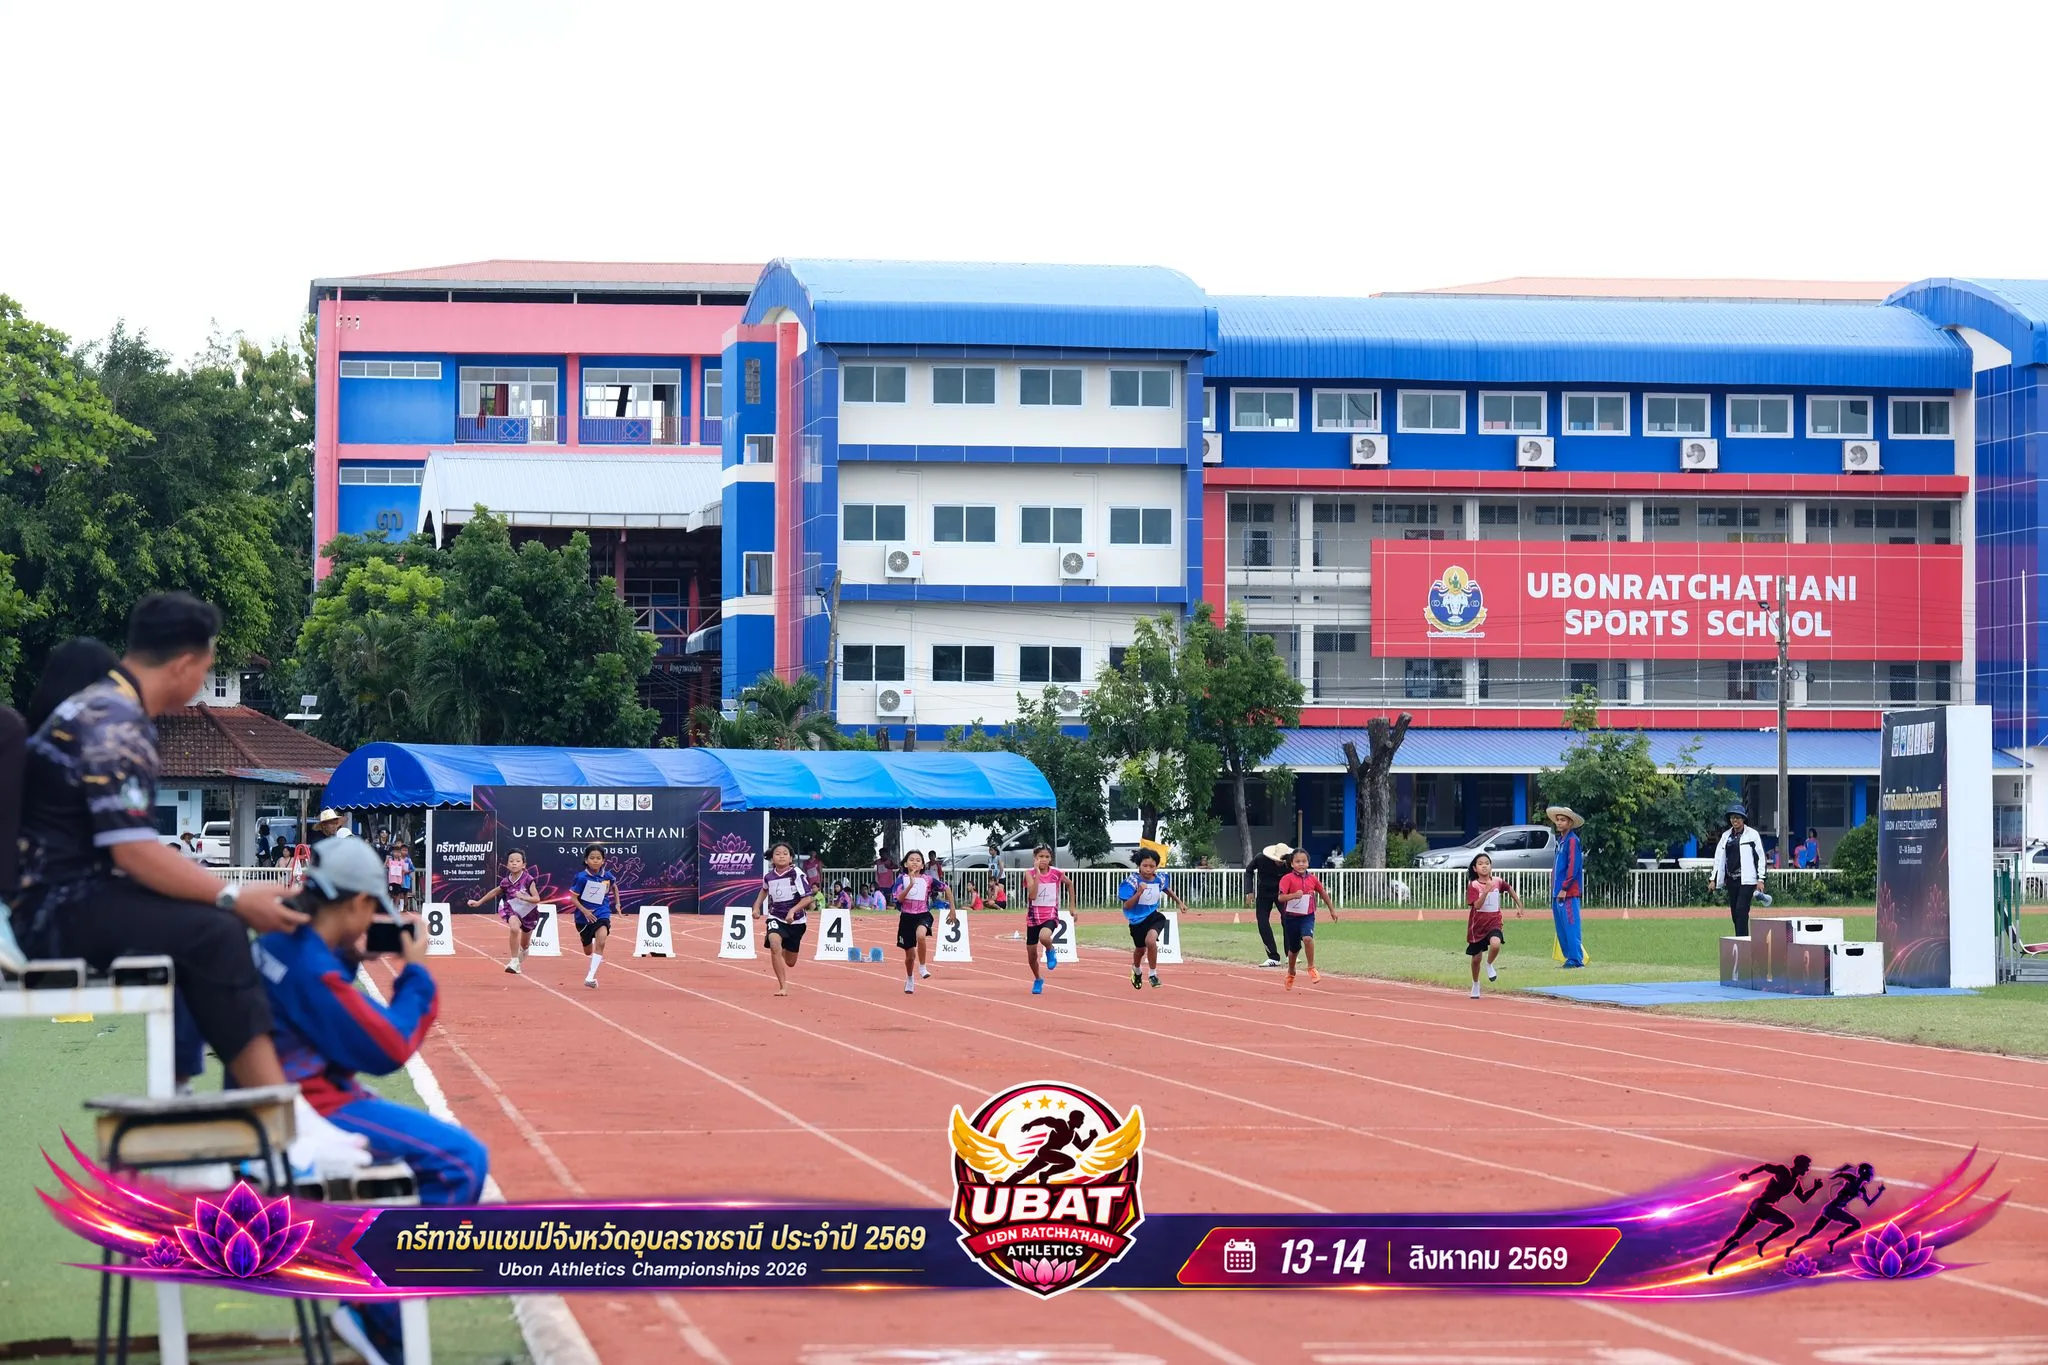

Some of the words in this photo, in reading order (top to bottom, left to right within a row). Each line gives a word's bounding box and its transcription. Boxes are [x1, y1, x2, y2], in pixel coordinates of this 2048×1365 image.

[1526, 572, 1857, 601] UBONRATCHATHANI
[1565, 609, 1689, 637] SPORTS
[1707, 609, 1832, 637] SCHOOL
[512, 826, 565, 838] UBON
[572, 826, 685, 839] RATCHATHANI
[709, 853, 756, 864] UBON
[709, 863, 755, 871] ATHLETICS
[590, 886, 601, 898] 7
[776, 882, 783, 896] 6
[1038, 887, 1049, 902] 4
[427, 910, 444, 936] 8
[536, 912, 549, 937] 7
[646, 912, 663, 938] 6
[730, 914, 746, 940] 5
[827, 917, 844, 943] 4
[945, 918, 961, 943] 3
[1052, 919, 1068, 944] 2
[1732, 943, 1739, 981] 2
[1766, 929, 1773, 983] 1
